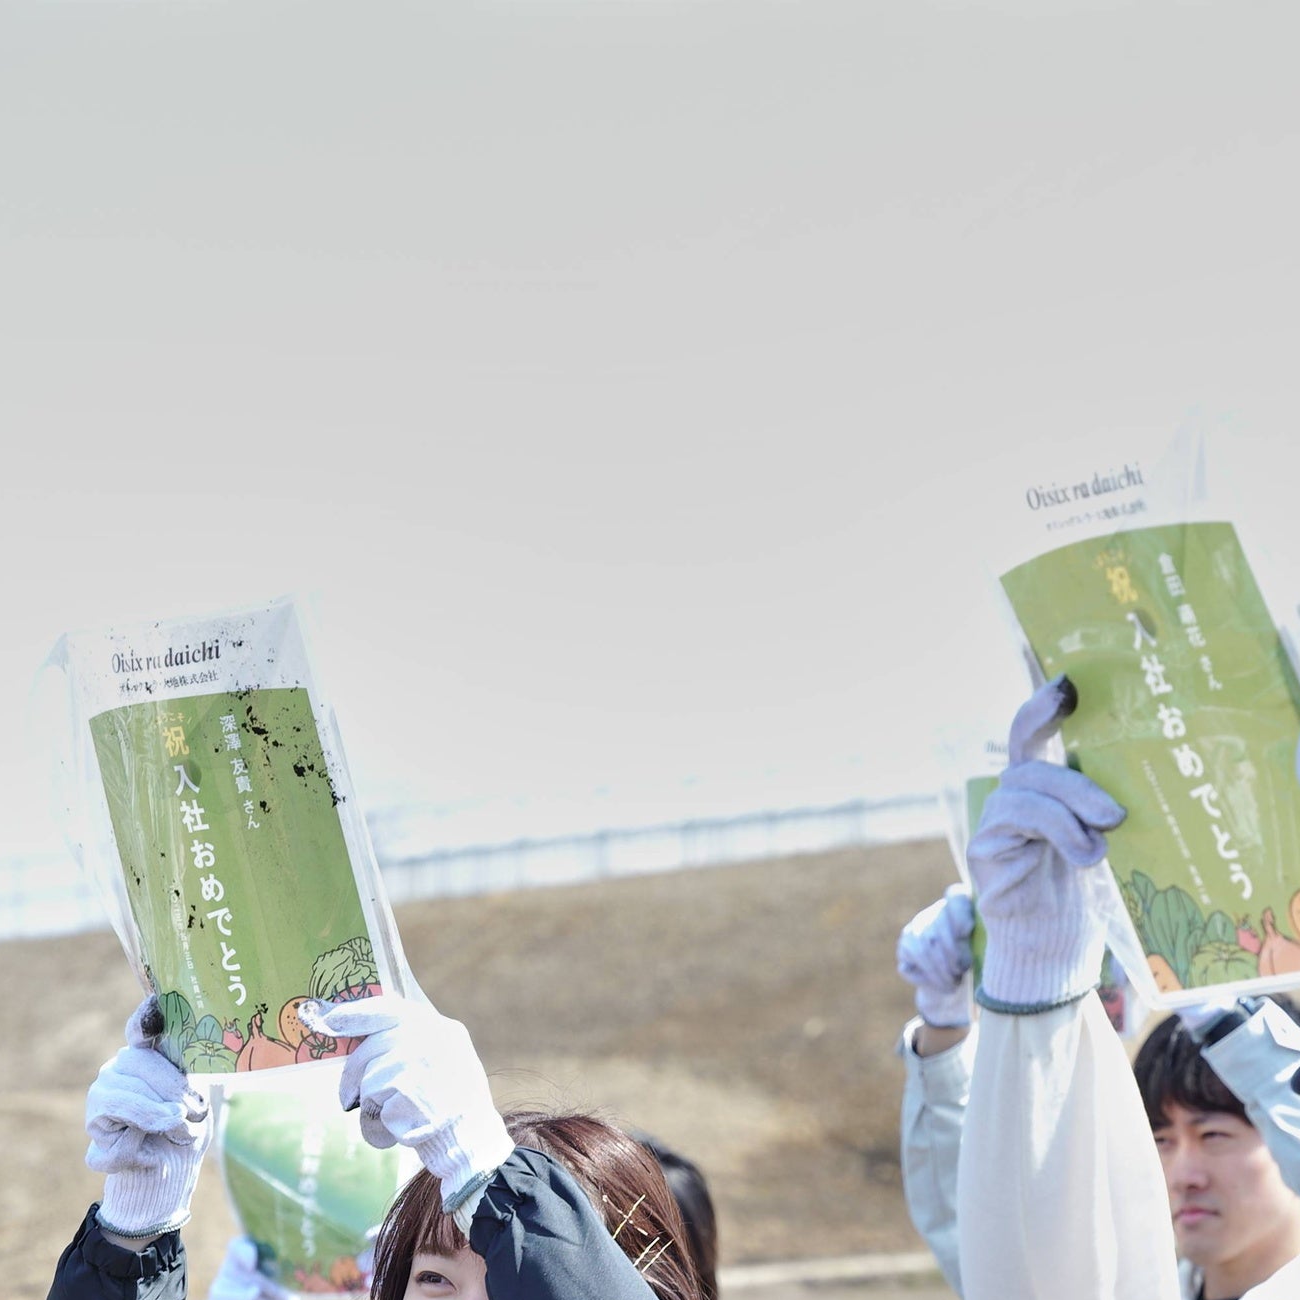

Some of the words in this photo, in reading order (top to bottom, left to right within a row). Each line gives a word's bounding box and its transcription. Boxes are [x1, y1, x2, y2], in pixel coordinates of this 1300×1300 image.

[1026, 482, 1071, 511] Oisix
[1072, 482, 1090, 500] ra
[1092, 461, 1144, 496] daichi
[111, 651, 143, 674] Oisix
[146, 655, 161, 672] ra
[164, 639, 221, 668] daichi
[163, 726, 189, 757] 祝
[1126, 612, 1253, 900] 入社おめでとう
[230, 758, 252, 794] 友貴
[243, 799, 260, 830] さん
[174, 764, 247, 1007] 入社おめでとう
